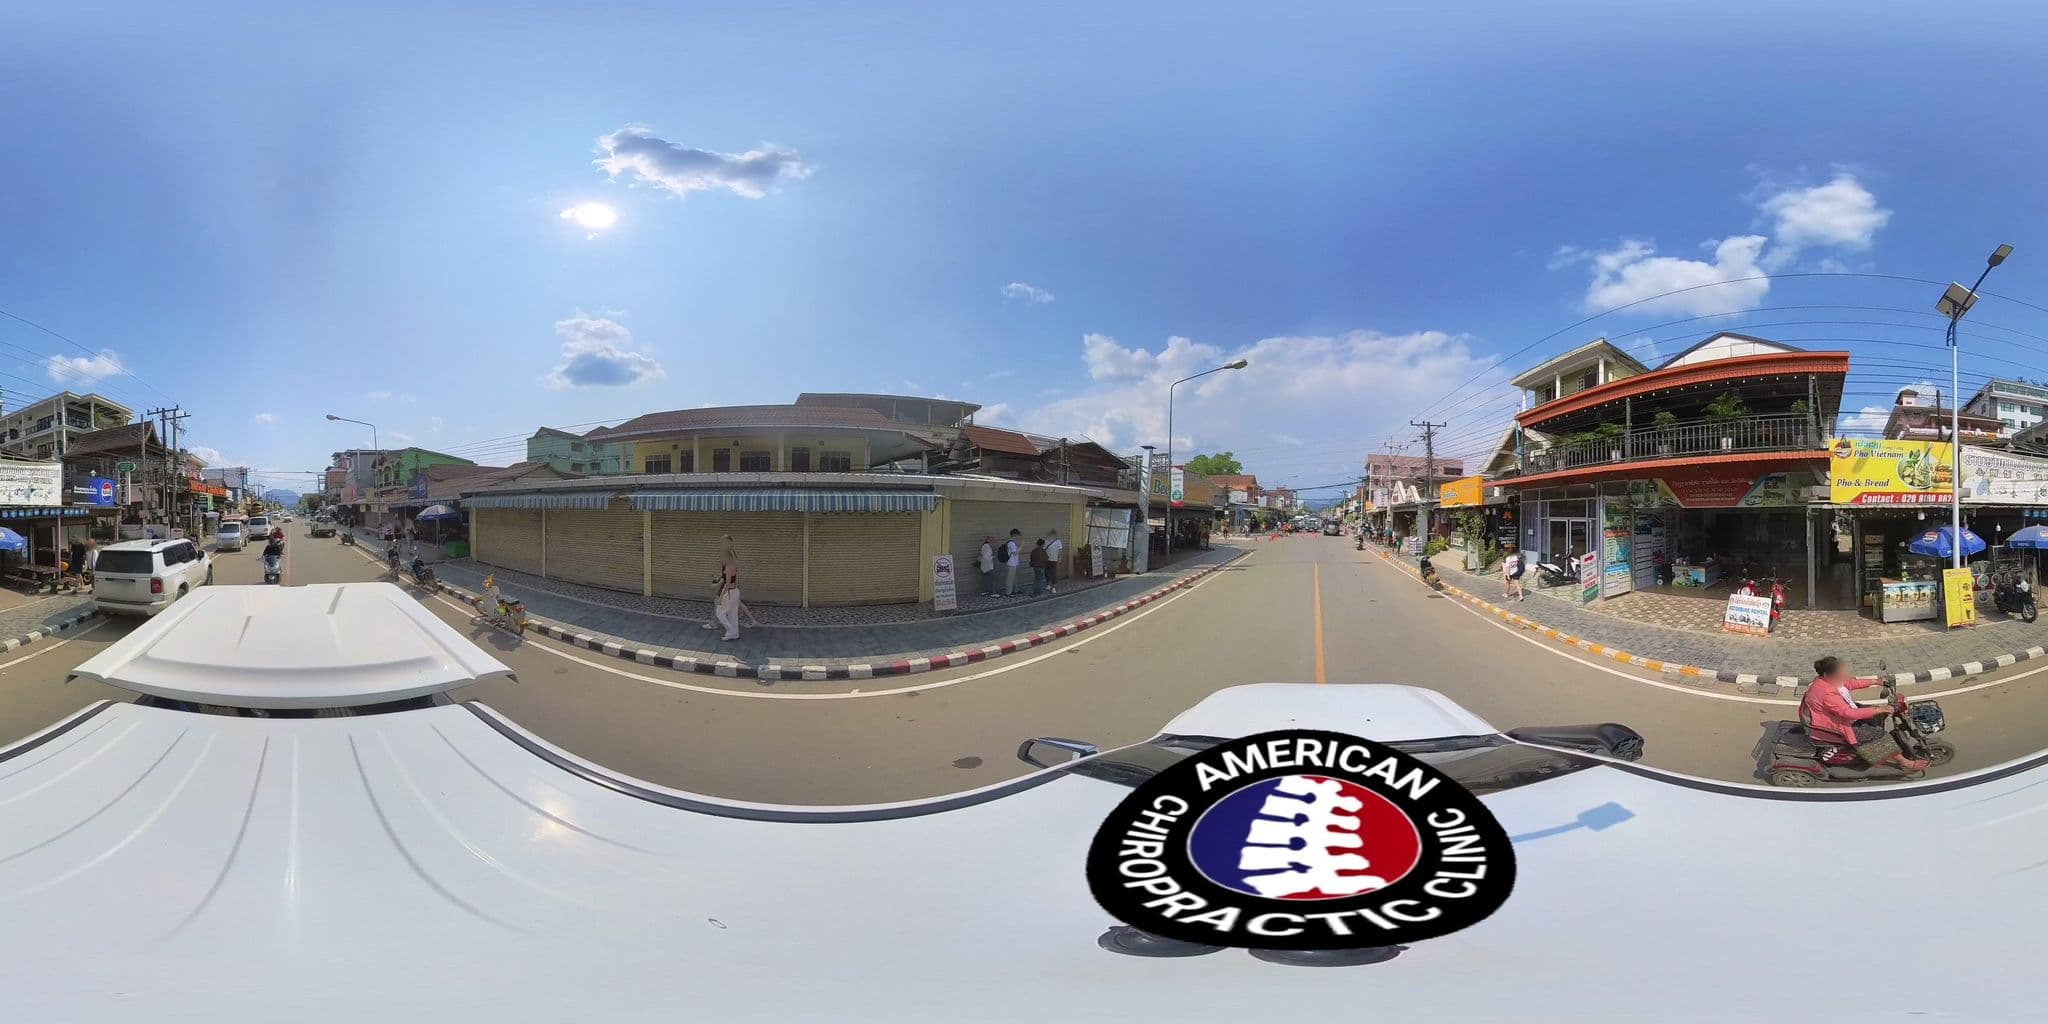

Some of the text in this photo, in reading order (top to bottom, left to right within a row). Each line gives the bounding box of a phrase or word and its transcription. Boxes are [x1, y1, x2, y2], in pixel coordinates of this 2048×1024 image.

[1854, 450, 1904, 458] Pho Vietnam
[1836, 479, 1889, 487] Pho & Bread
[1862, 494, 1894, 503] Contact
[1901, 494, 1917, 503] 020
